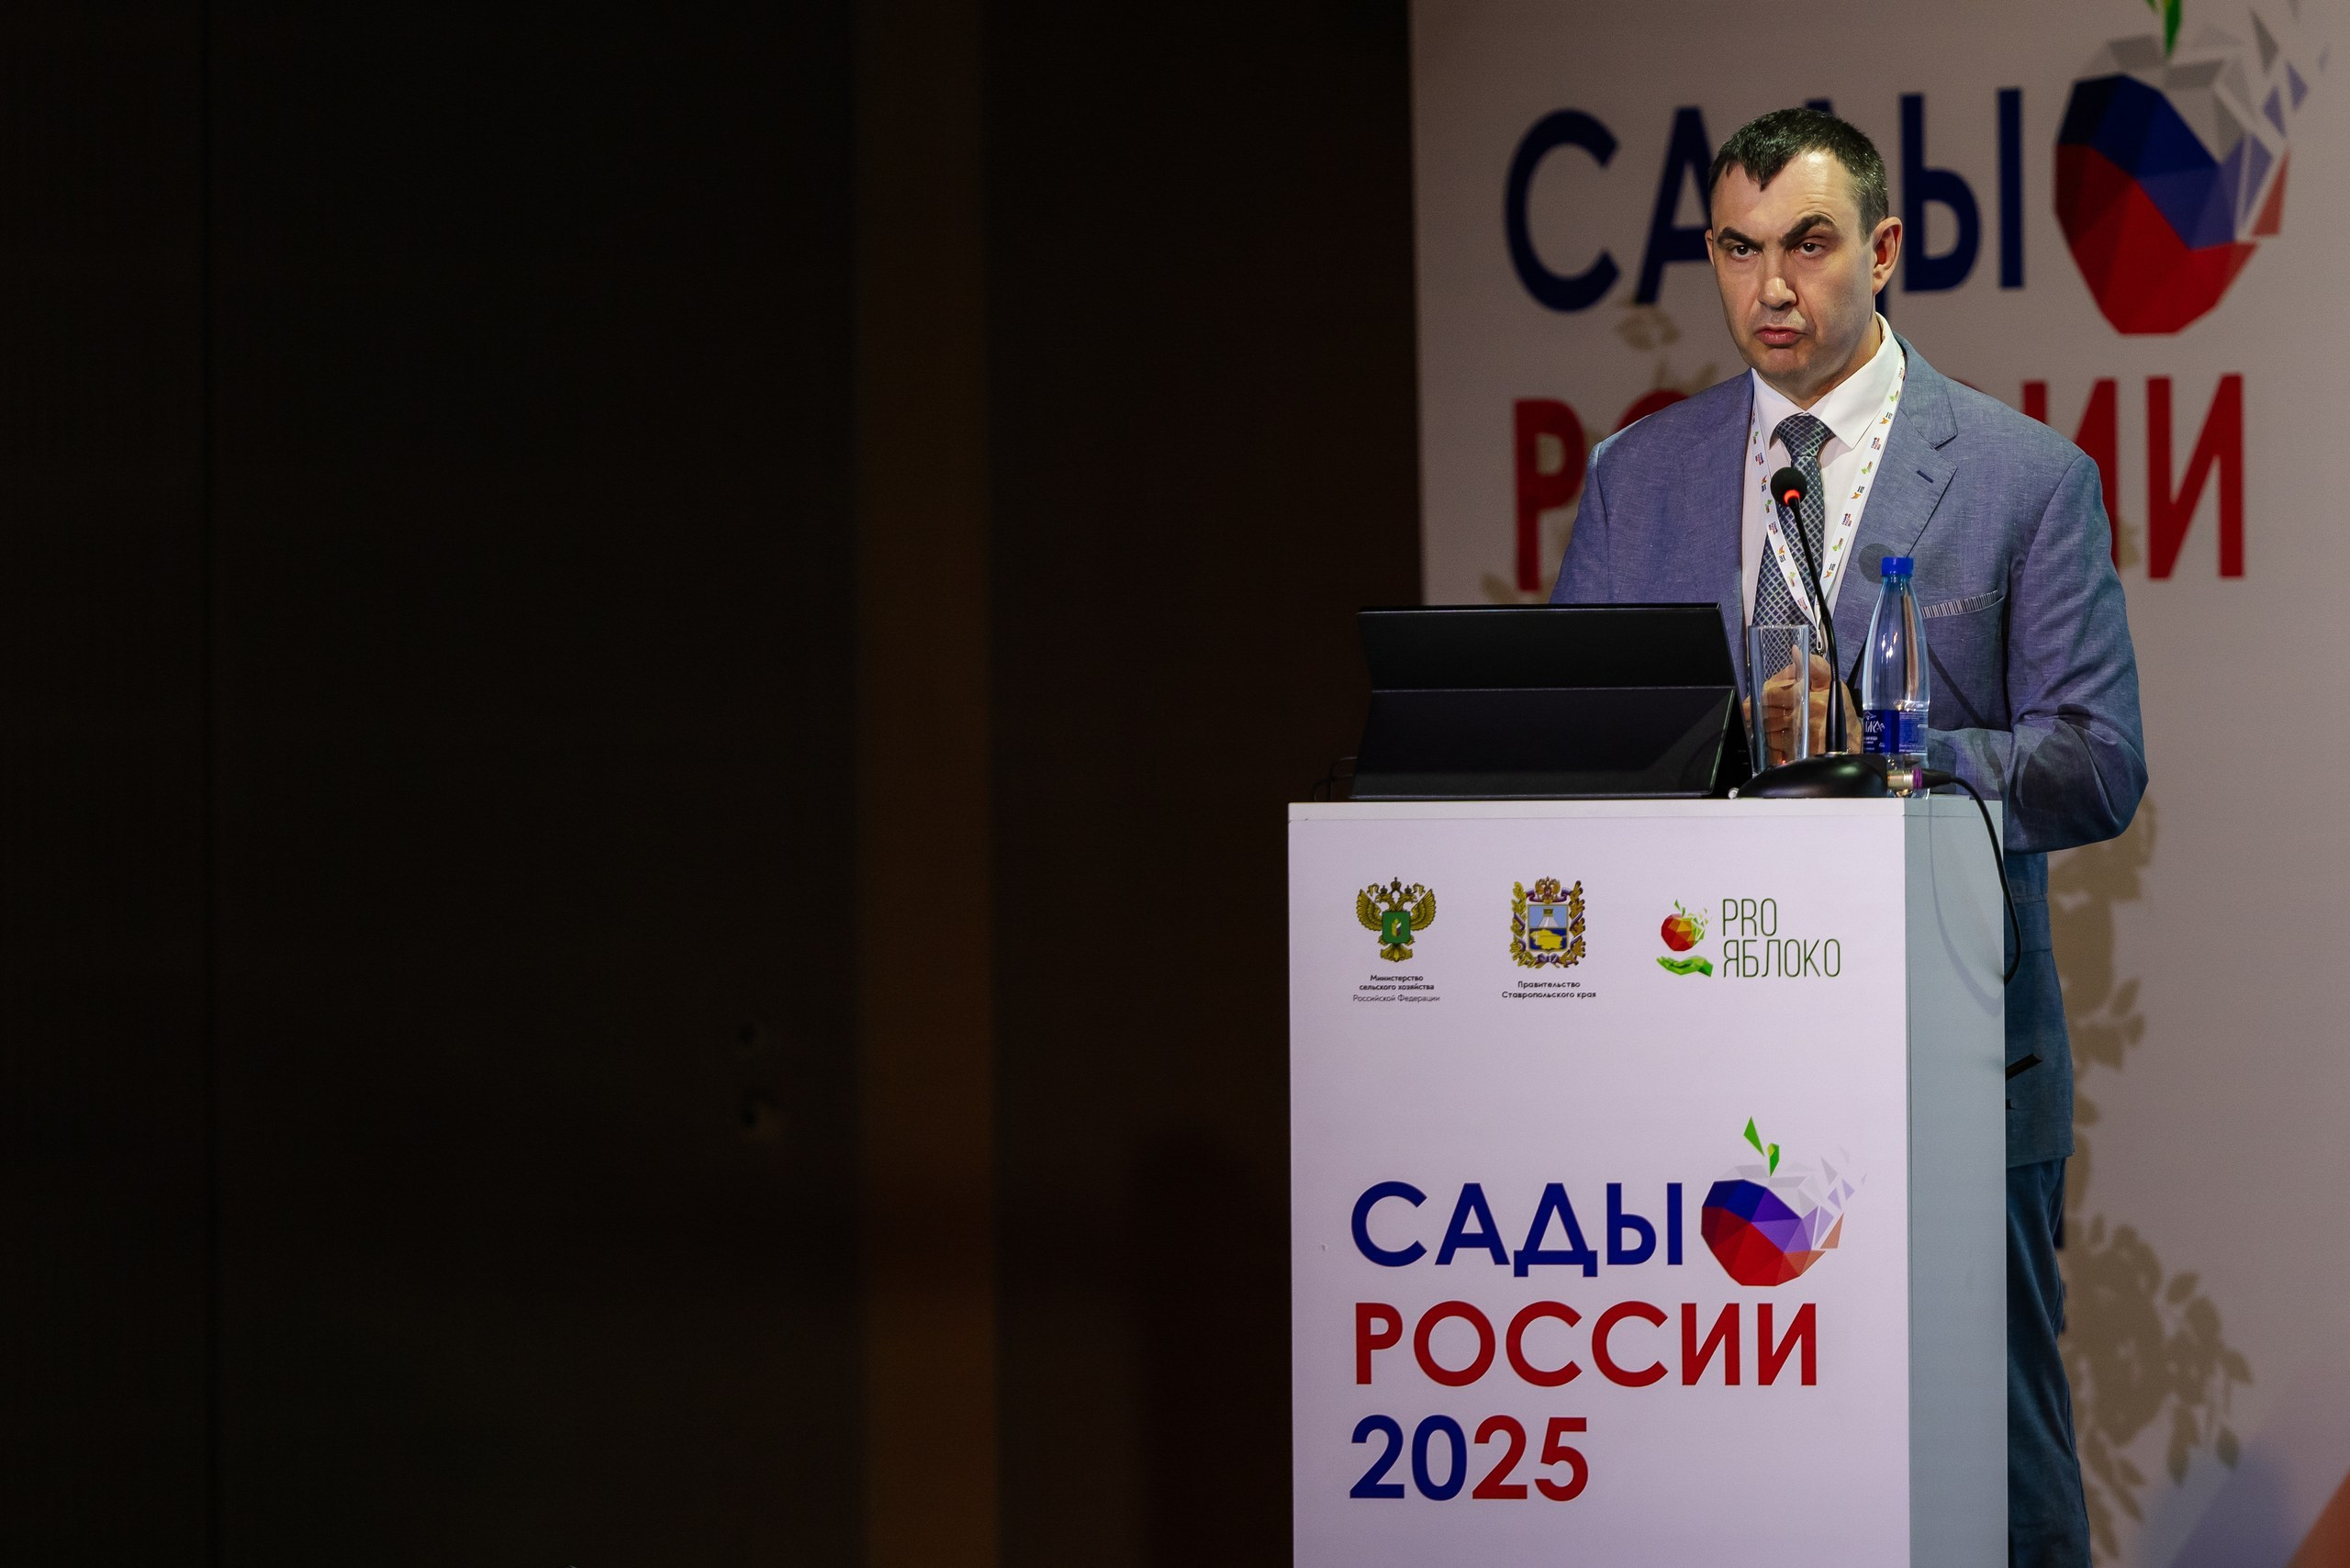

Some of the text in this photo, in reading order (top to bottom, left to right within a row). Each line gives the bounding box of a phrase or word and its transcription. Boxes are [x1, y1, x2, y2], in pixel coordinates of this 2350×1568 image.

[1505, 87, 2025, 317] САЫ
[1722, 898, 1778, 936] PRO
[1722, 939, 1841, 978] ЯБЛОКО
[1370, 974, 1424, 983] Министерство
[1397, 982, 1435, 991] хозяйства
[1501, 991, 1596, 1000] Ставропольского края
[1517, 980, 1581, 990] Правительство
[1352, 993, 1440, 1003] Российской Федерации
[1351, 1181, 1684, 1277] САДЫ
[1355, 1300, 1818, 1387] РОССИИ
[1349, 1414, 1589, 1502] 2025
